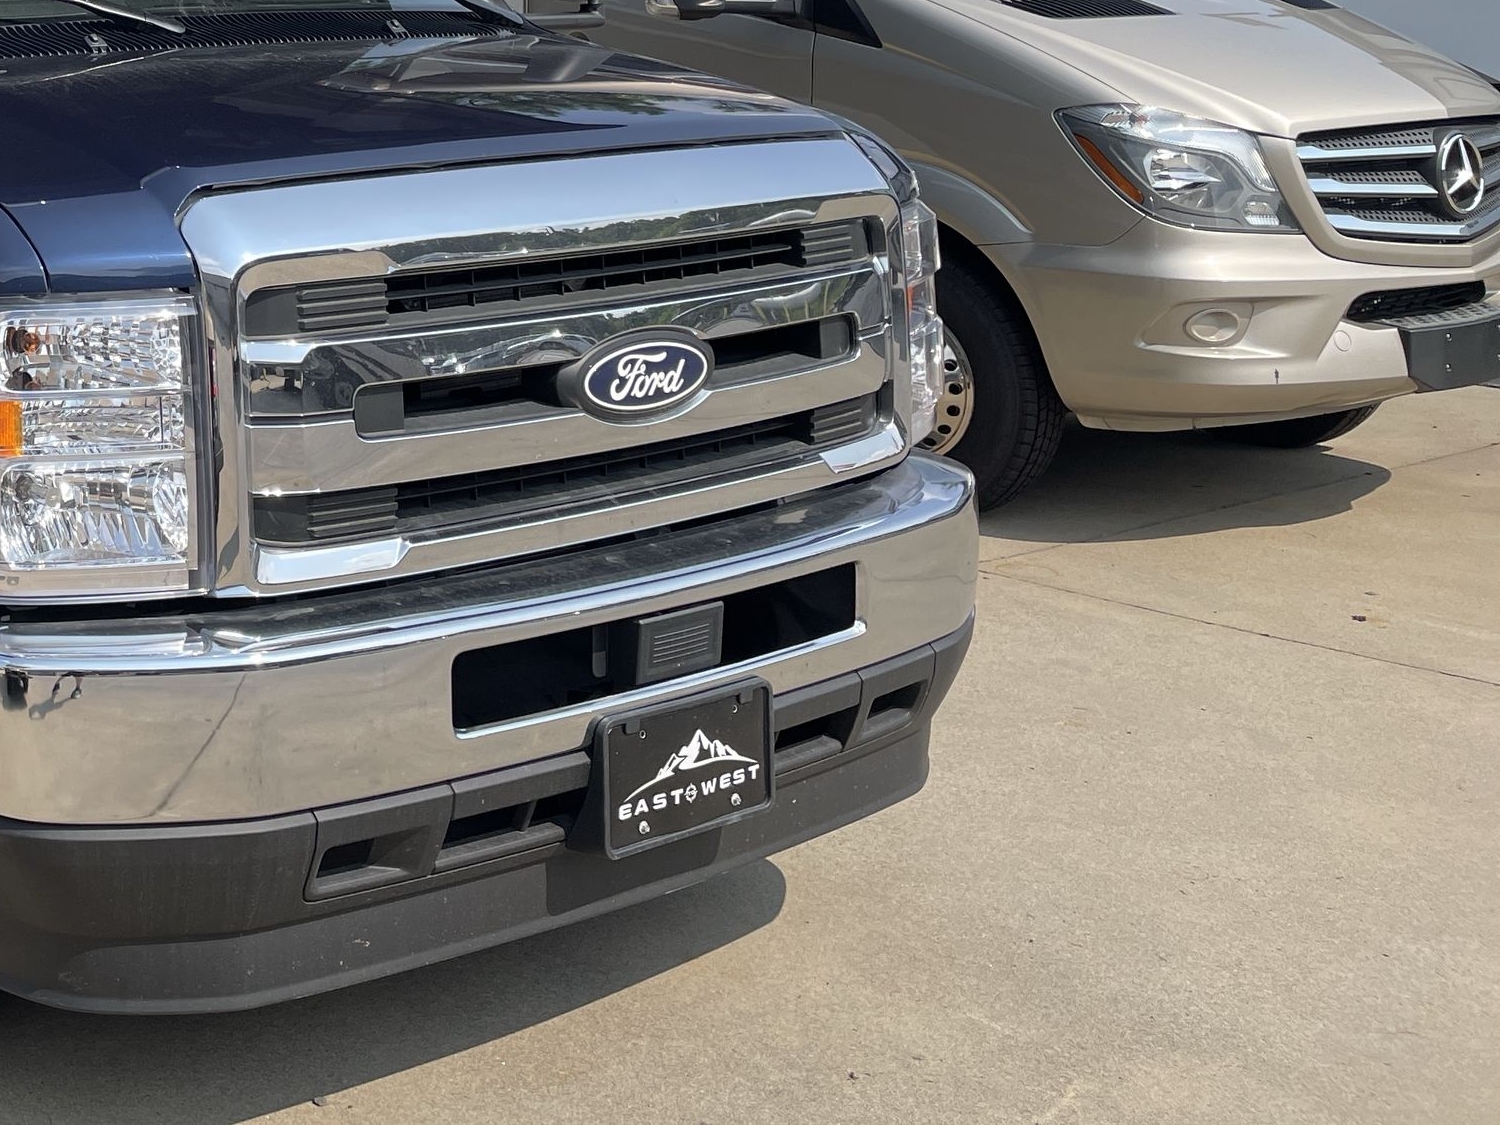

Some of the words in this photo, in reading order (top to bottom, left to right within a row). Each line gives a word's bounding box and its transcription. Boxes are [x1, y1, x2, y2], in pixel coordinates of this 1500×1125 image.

[610, 350, 686, 402] Ford
[618, 787, 685, 821] EAST
[700, 763, 761, 797] WEST
